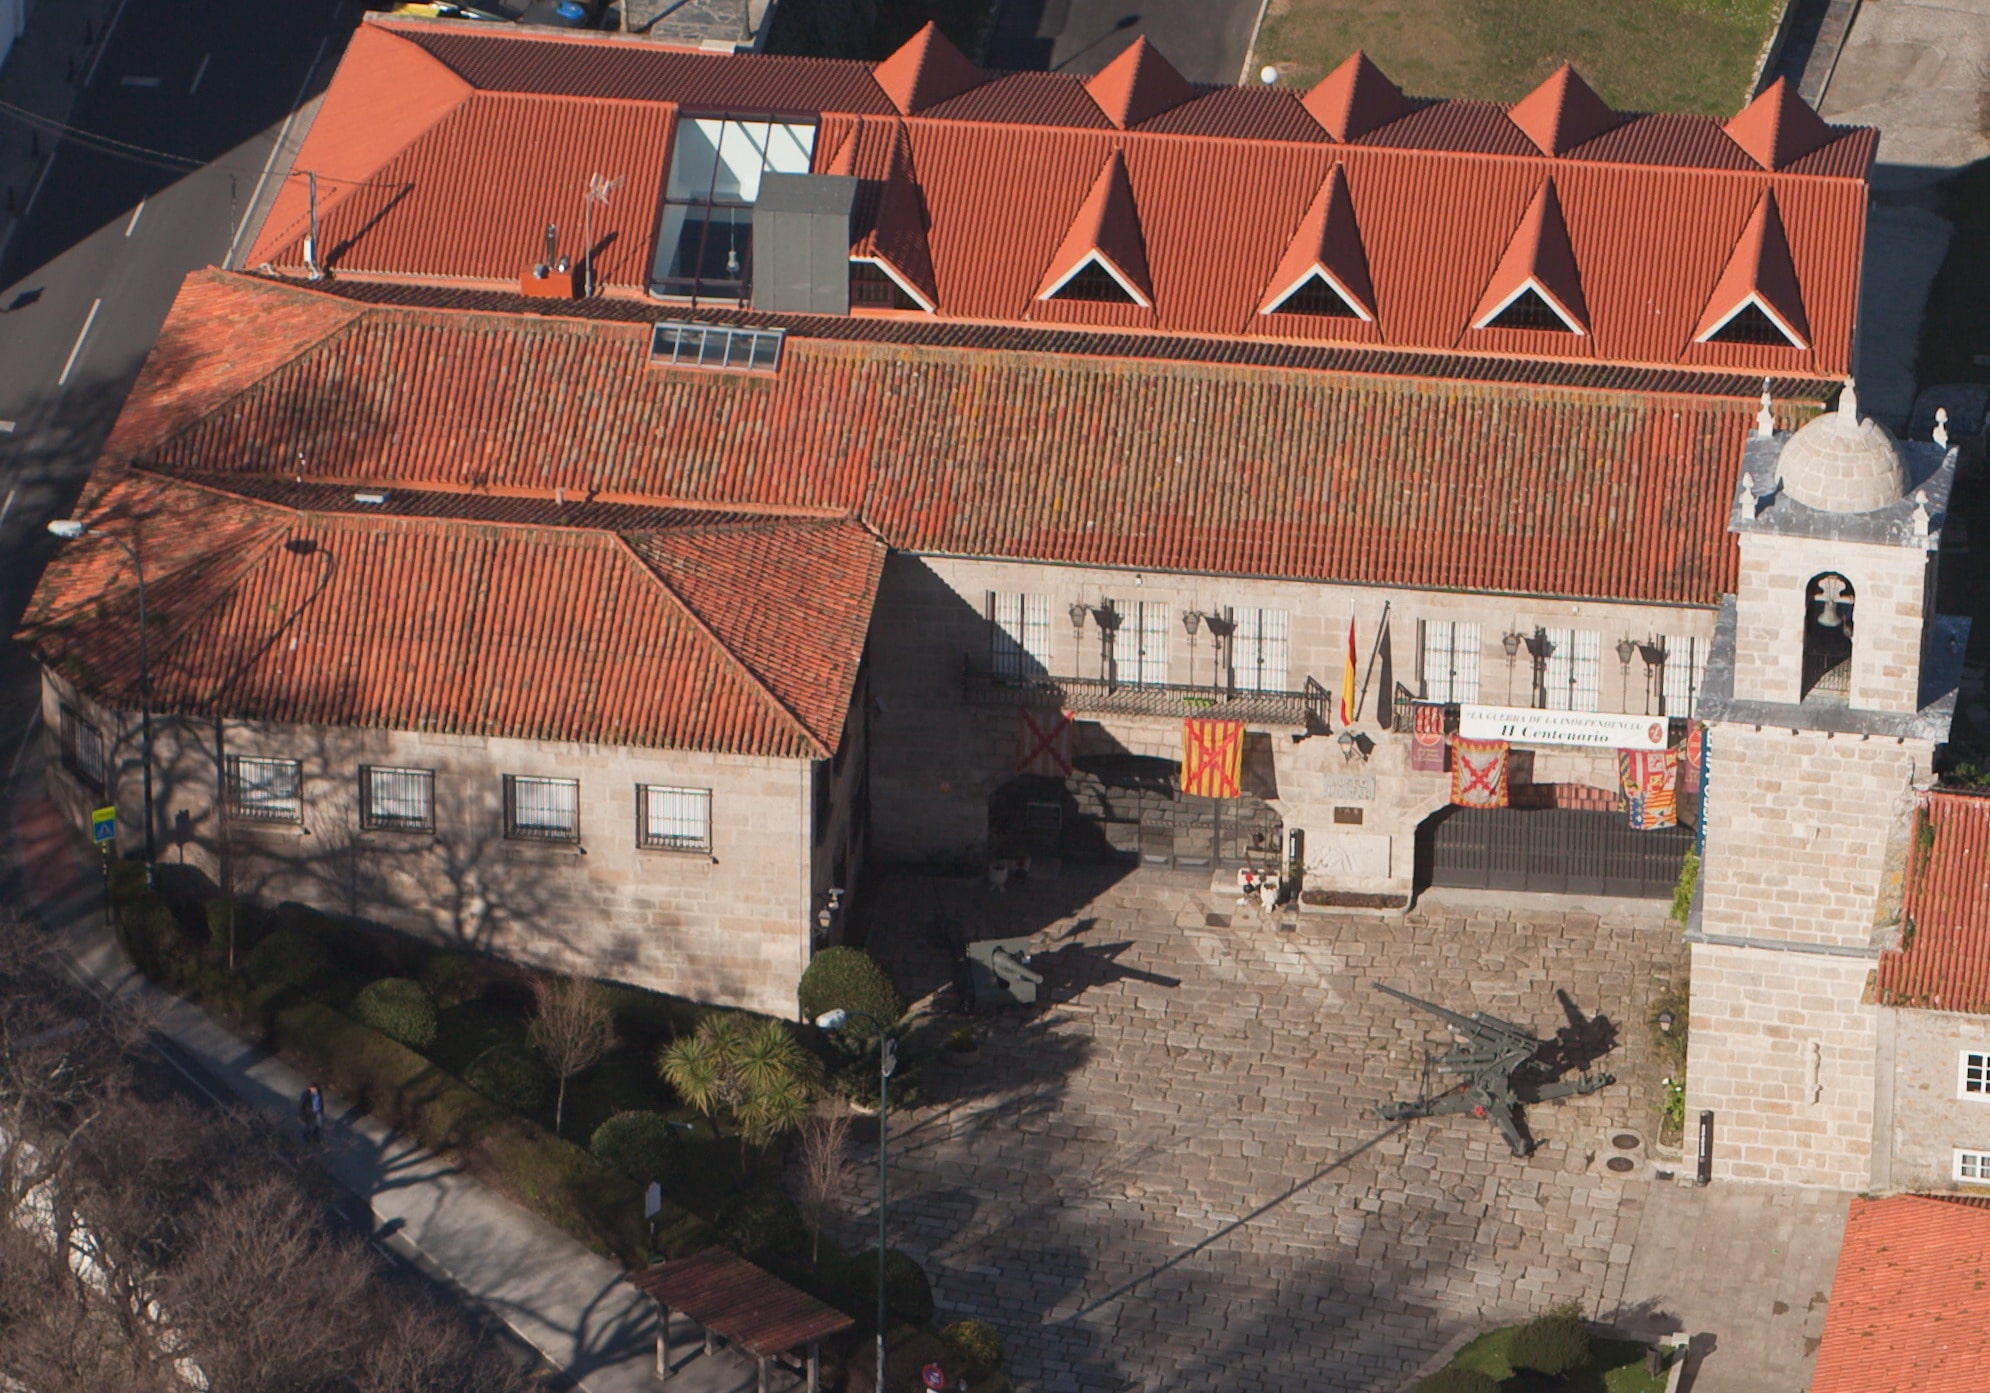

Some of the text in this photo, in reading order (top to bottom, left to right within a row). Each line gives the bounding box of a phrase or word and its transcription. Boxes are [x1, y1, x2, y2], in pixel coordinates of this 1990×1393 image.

[1486, 712, 1526, 723] GUERRA
[1529, 715, 1542, 724] DE
[1545, 716, 1558, 724] LA
[1522, 727, 1609, 742] Centenario
